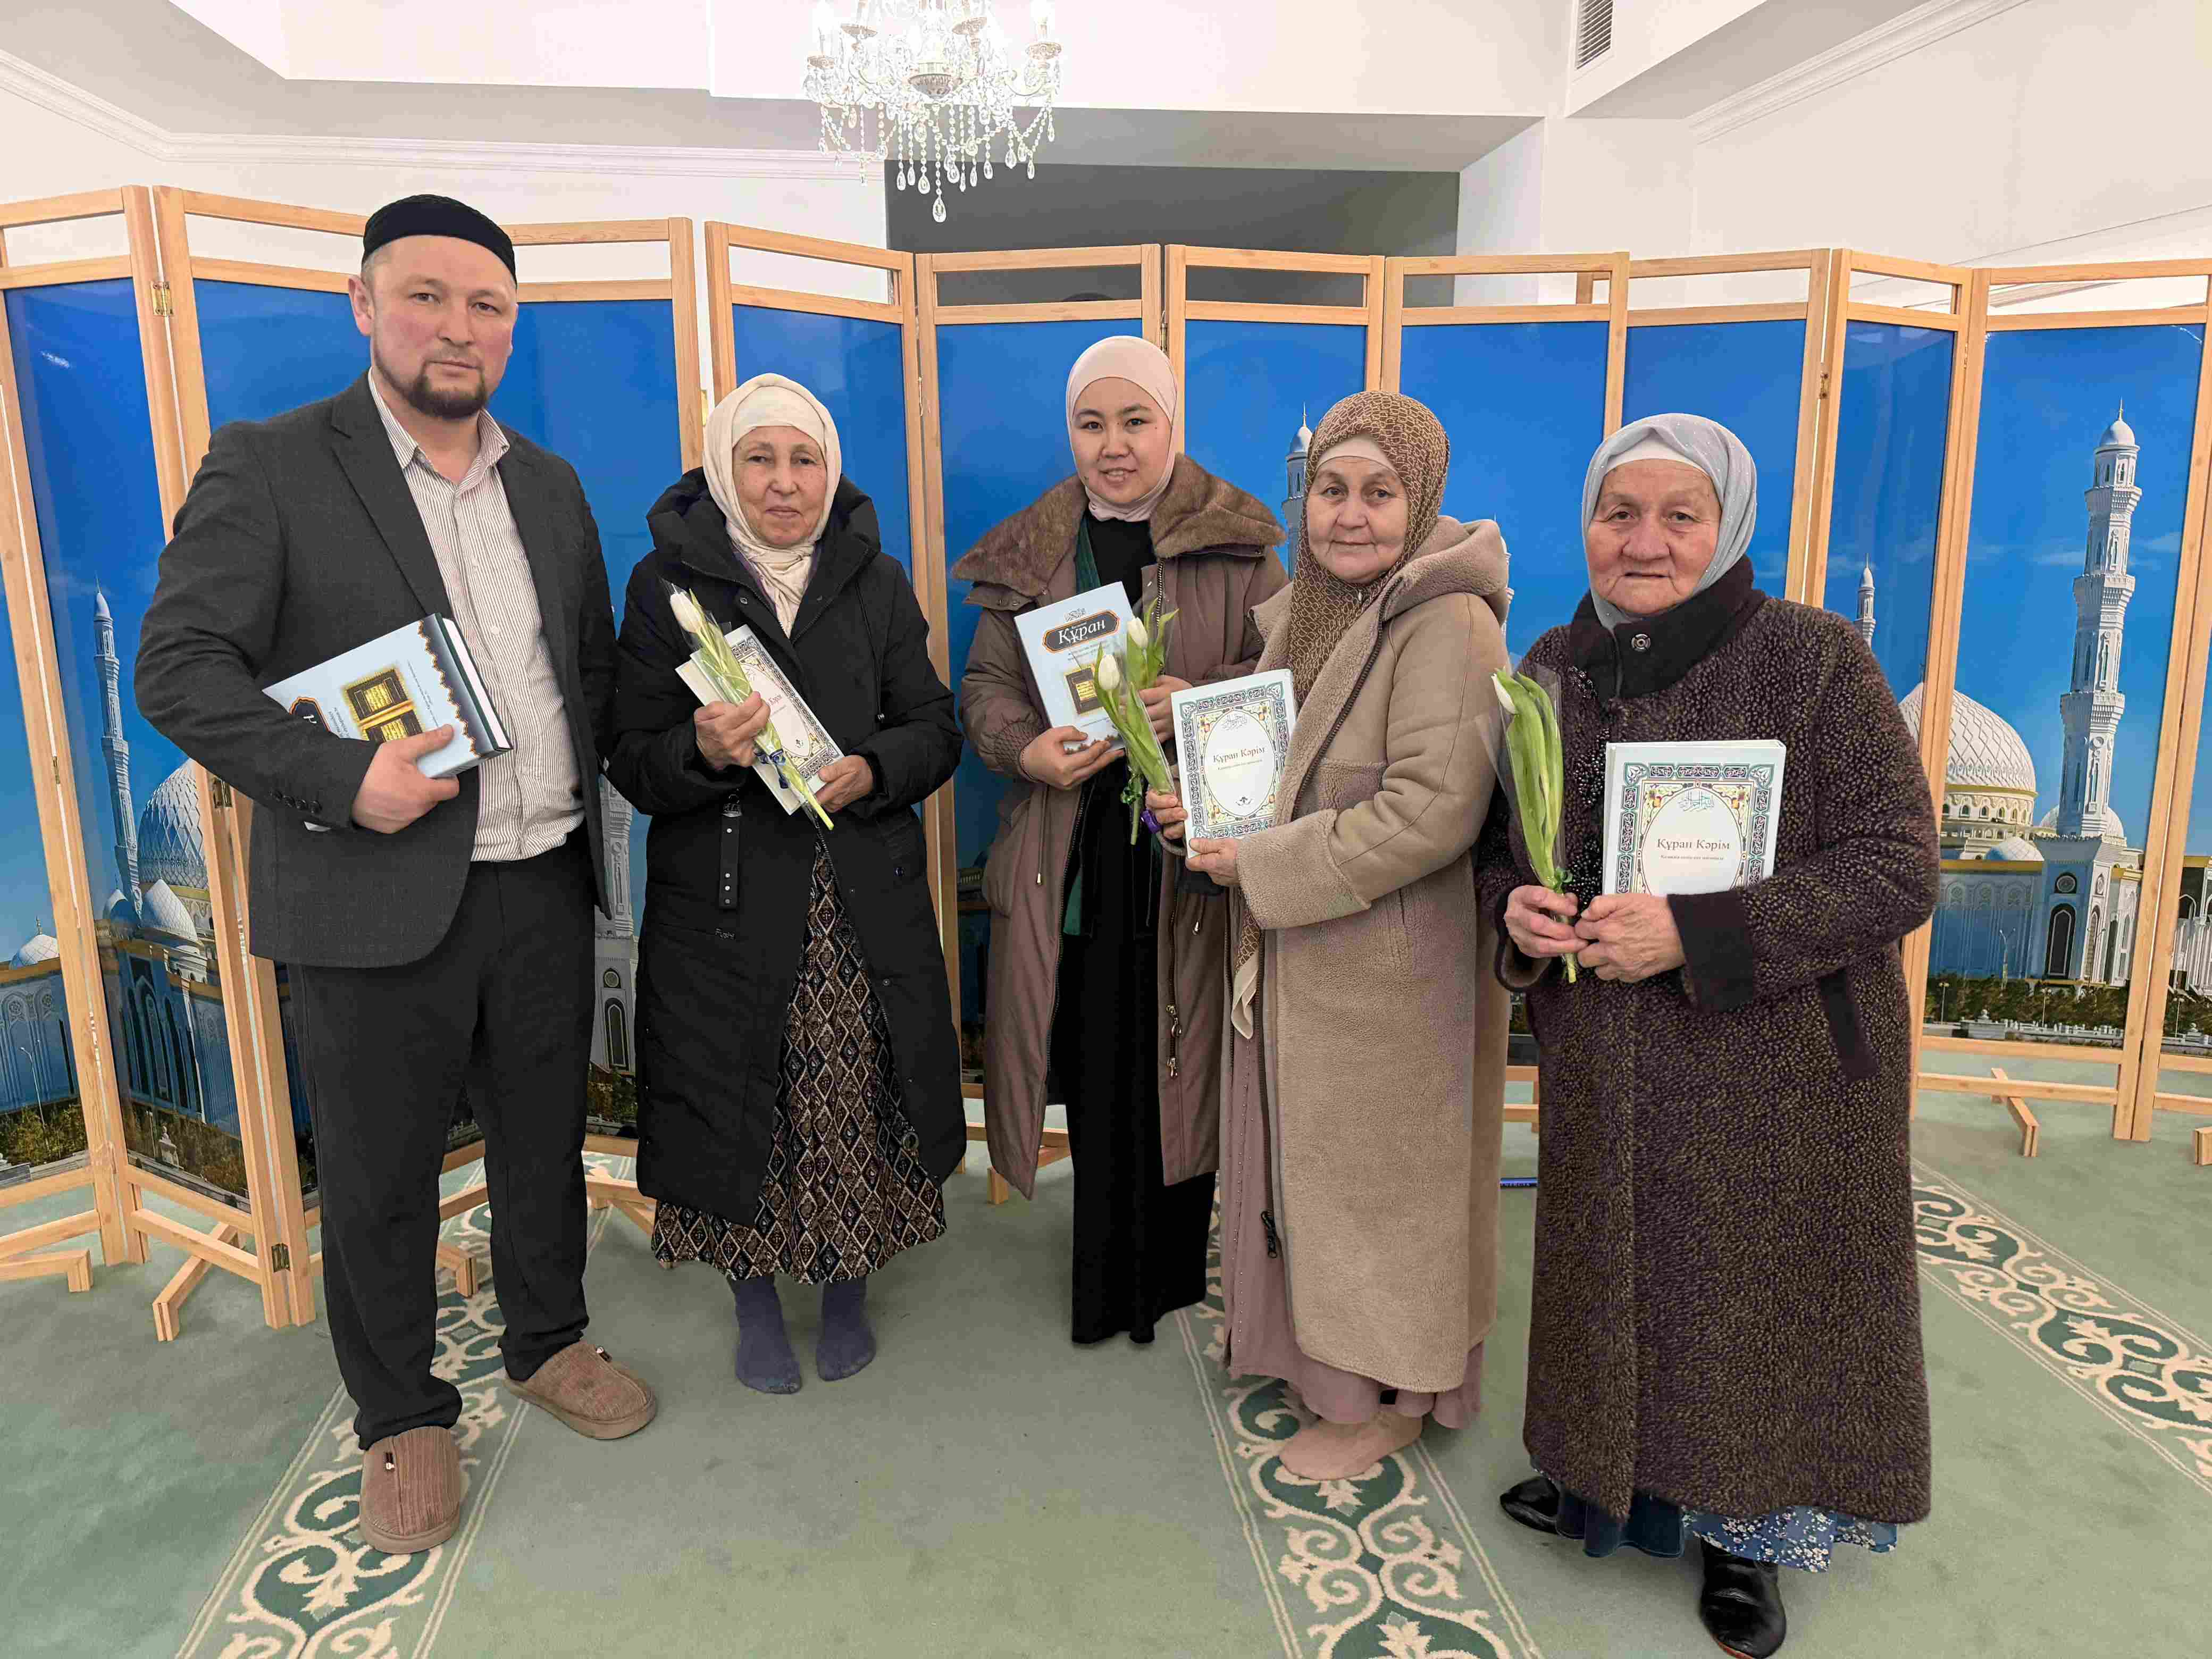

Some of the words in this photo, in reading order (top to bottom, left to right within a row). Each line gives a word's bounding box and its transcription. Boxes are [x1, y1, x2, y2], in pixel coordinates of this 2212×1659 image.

[1058, 619, 1105, 644] Құран
[1657, 838, 1692, 851] Құран
[1697, 839, 1730, 851] Кәрім
